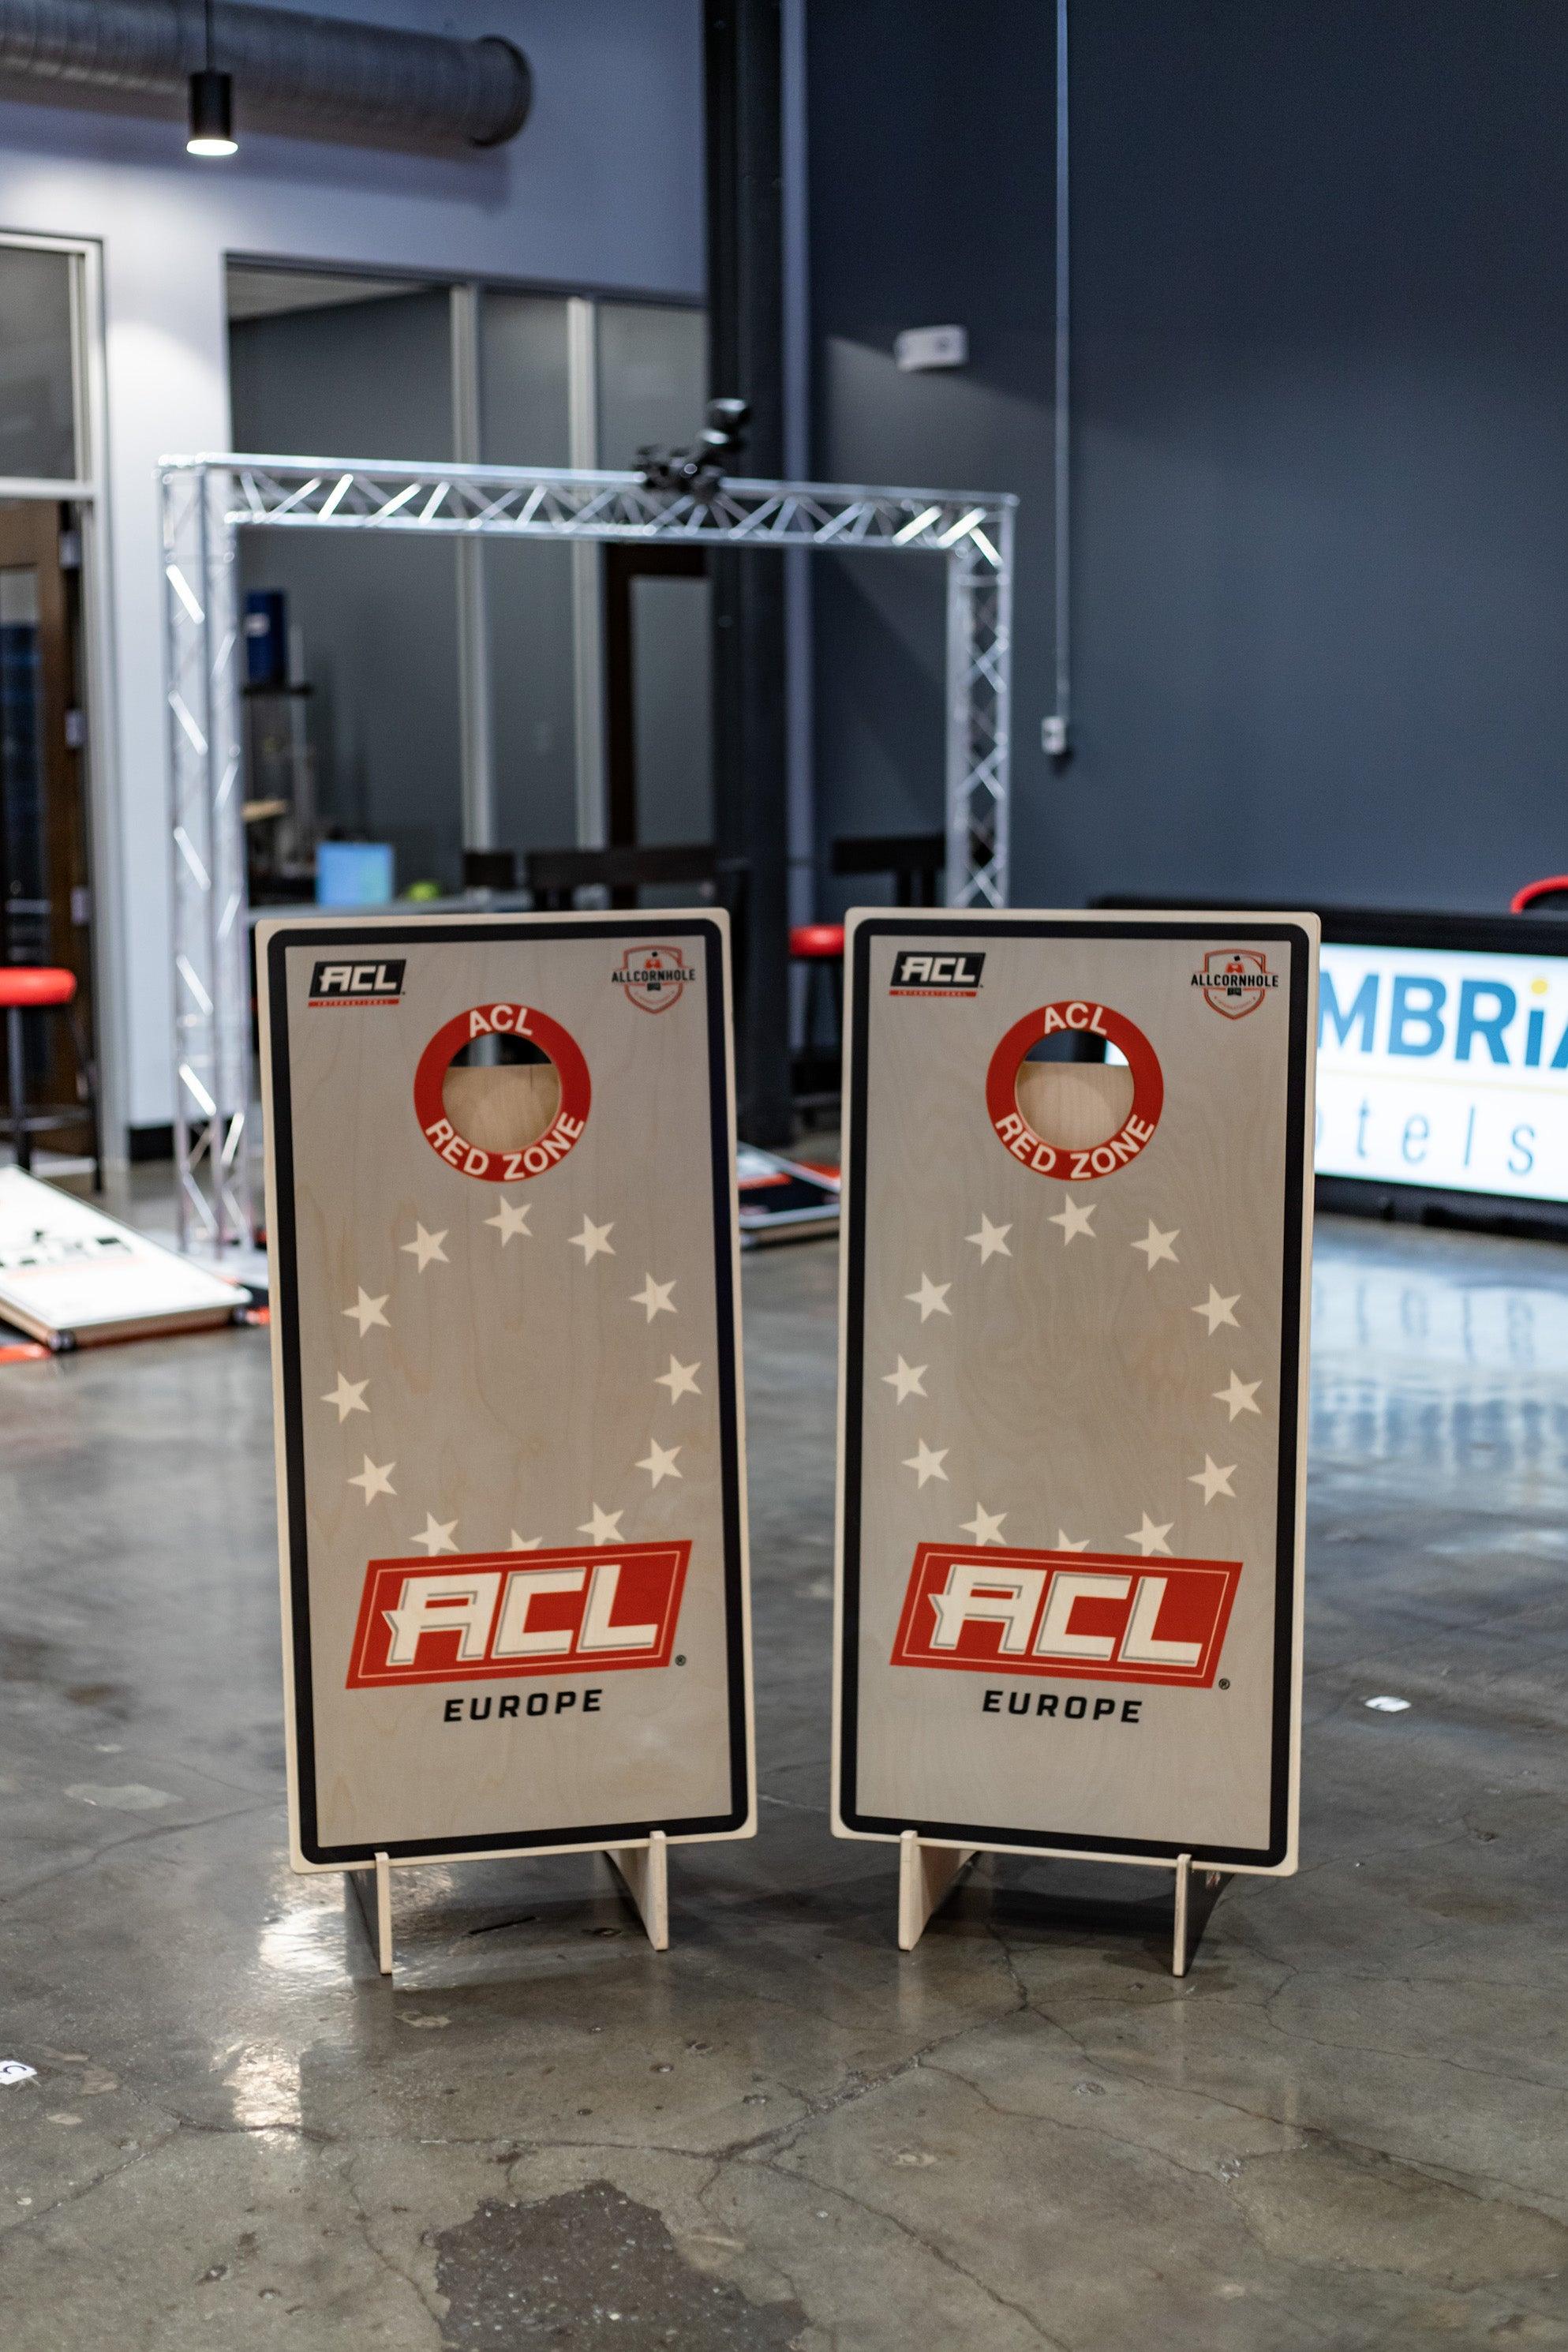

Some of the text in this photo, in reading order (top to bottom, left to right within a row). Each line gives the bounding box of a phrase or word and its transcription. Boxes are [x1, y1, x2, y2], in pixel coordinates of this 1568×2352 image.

[319, 964, 397, 992] ACL
[612, 969, 696, 983] ALLCORNHOLE
[901, 957, 975, 983] ACL
[1191, 974, 1279, 987] ALLCORNHOLE
[469, 1004, 533, 1039] ACL
[1044, 1002, 1108, 1036] ACL
[425, 1112, 585, 1181] RED ZONE
[995, 1112, 1154, 1179] RED ZONE
[1315, 1097, 1536, 1176] tels
[381, 1564, 658, 1667] ACL
[927, 1564, 1203, 1668] ACL
[443, 1689, 603, 1723] EUROPE
[982, 1690, 1143, 1724] EUROPE
